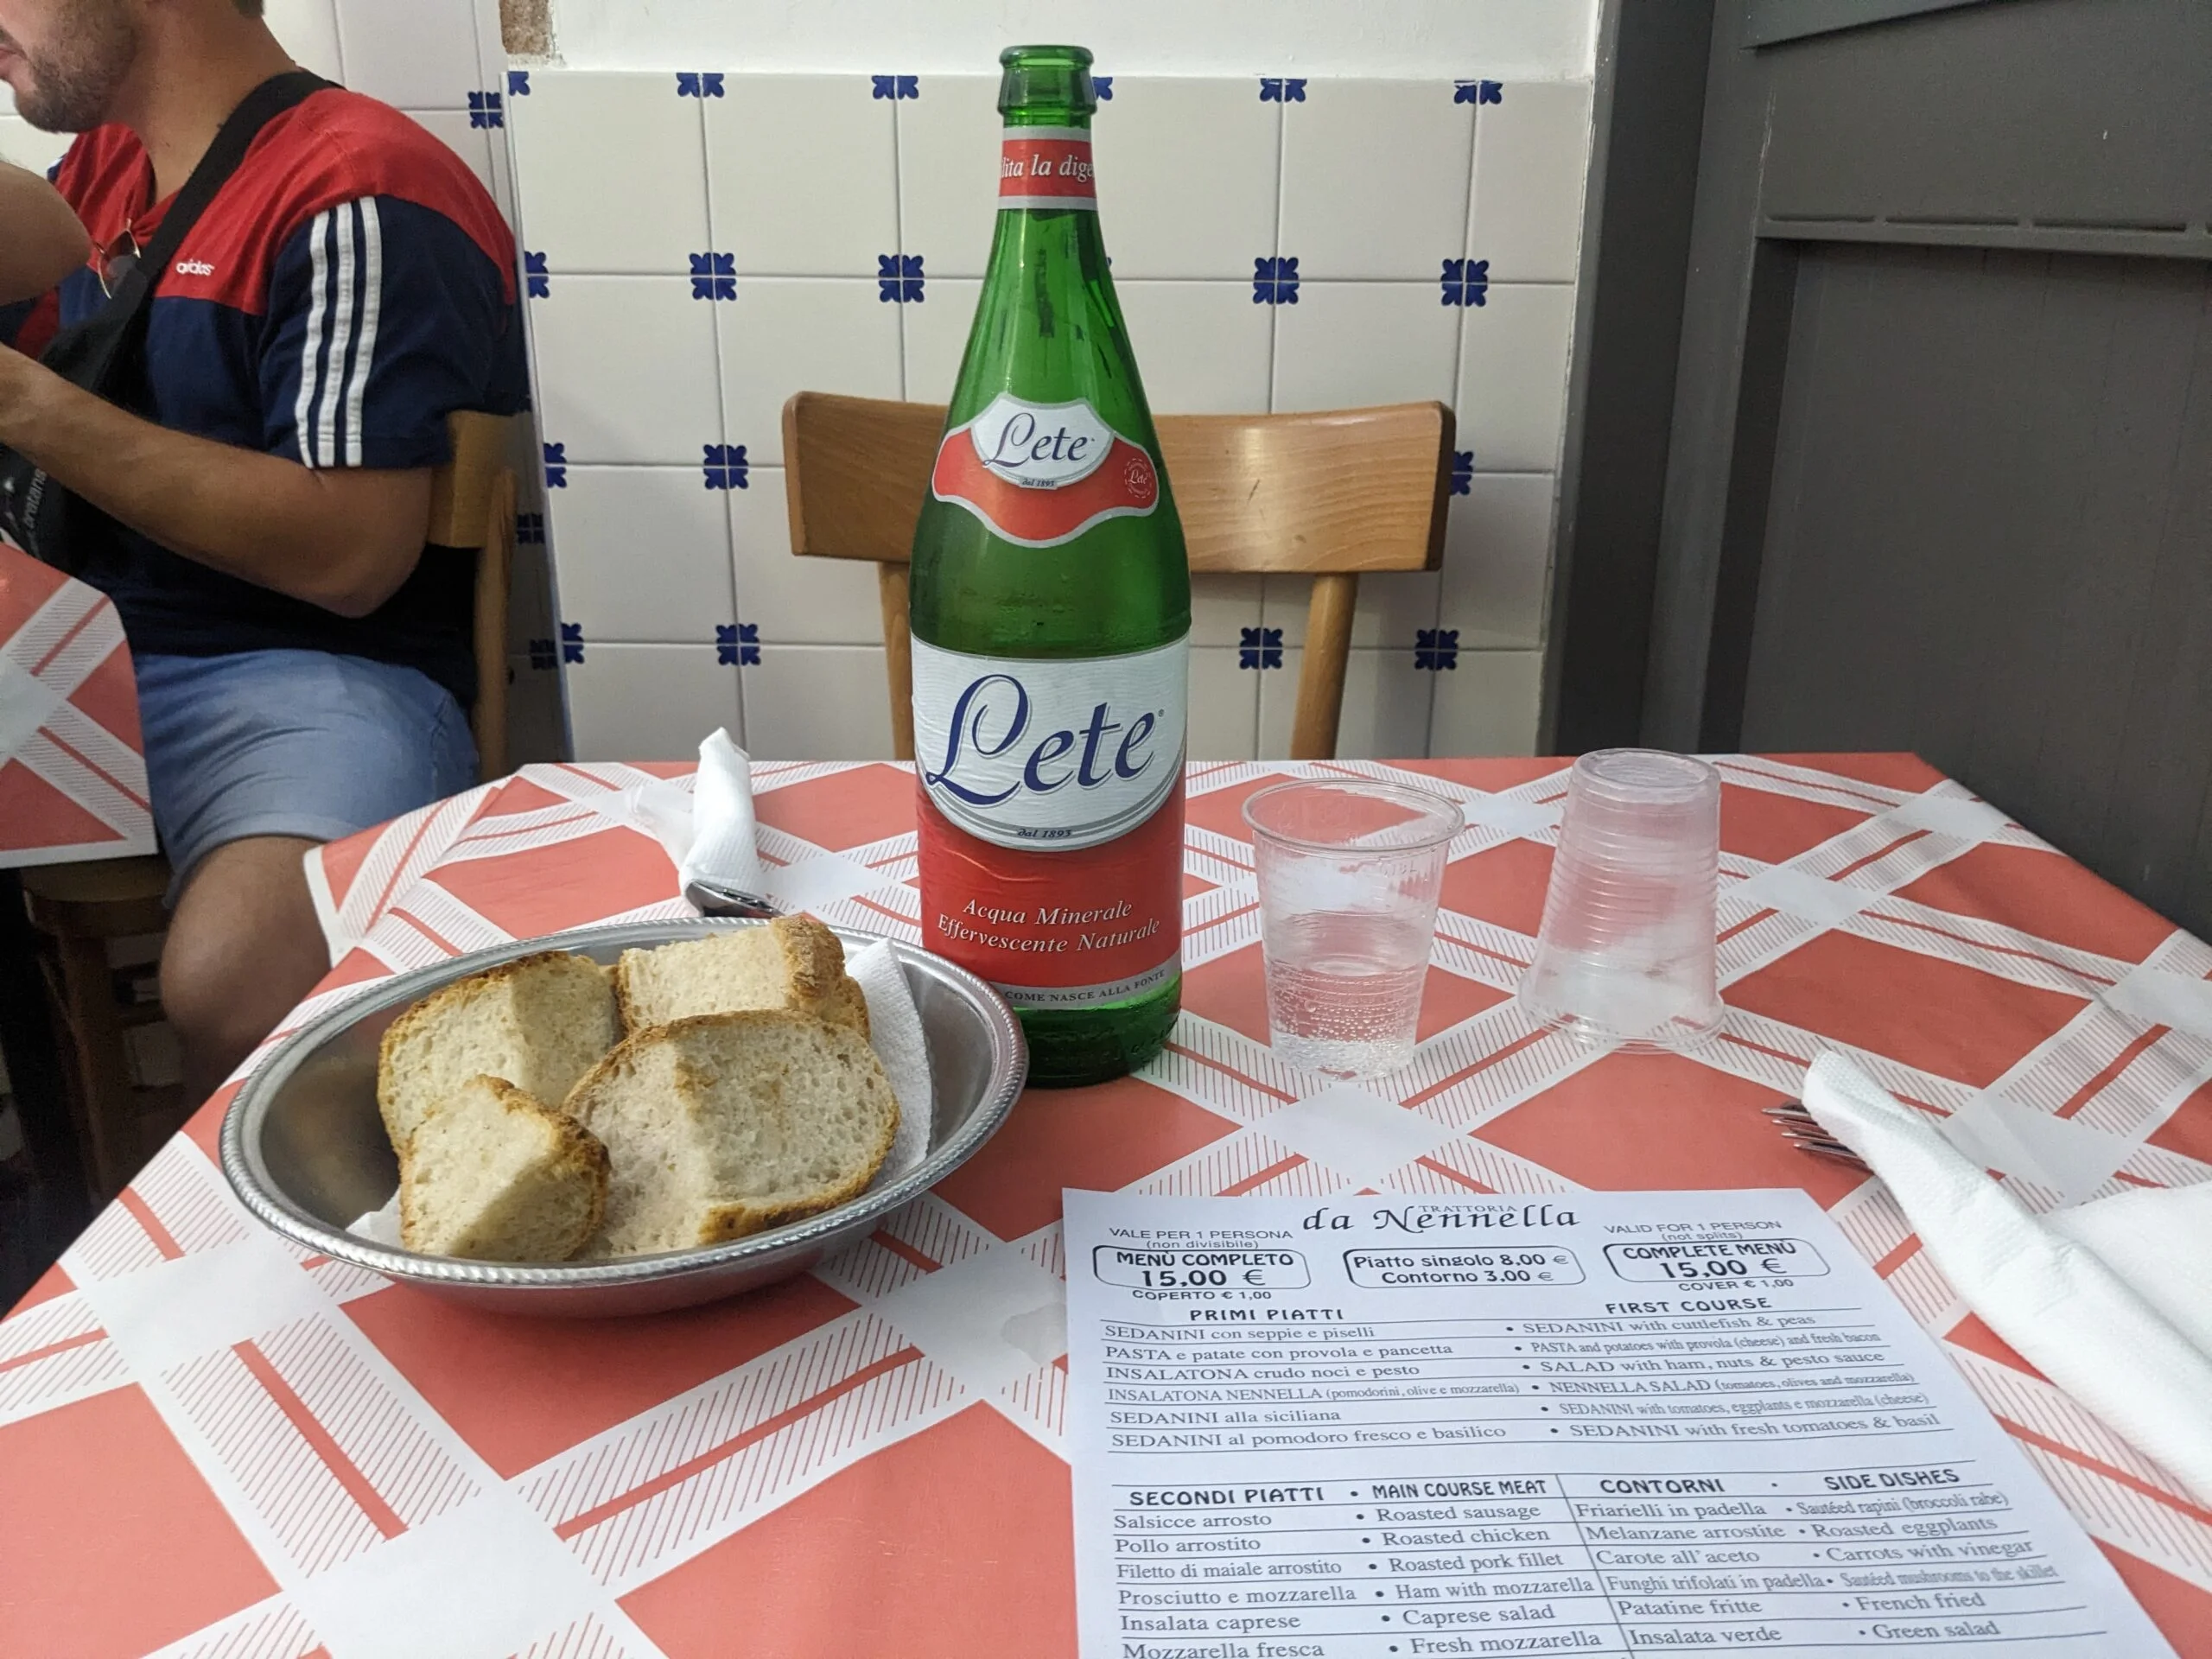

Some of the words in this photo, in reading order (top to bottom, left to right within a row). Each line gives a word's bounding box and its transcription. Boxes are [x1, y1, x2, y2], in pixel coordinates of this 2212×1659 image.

[1031, 154, 1052, 176] la
[982, 412, 1090, 467] Lete
[925, 674, 1155, 805] Lete
[1017, 828, 1039, 837] dal
[962, 899, 1027, 925] Acqua
[1033, 900, 1133, 925] Minerale
[938, 913, 1068, 952] Effervescente
[1077, 918, 1160, 951] Naturale
[1005, 991, 1045, 1001] COME
[1050, 991, 1095, 1002] NASCE
[1098, 985, 1131, 998] ALLA
[1134, 969, 1165, 989] FONTE
[1302, 1206, 1355, 1230] da
[1372, 1204, 1581, 1234] Nennella
[1603, 1224, 1653, 1234] VALID
[1656, 1223, 1694, 1233] FOR
[1696, 1223, 1706, 1231] 1
[1709, 1220, 1783, 1230] PERSON
[1109, 1227, 1152, 1239] VALE
[1155, 1230, 1191, 1240] PER
[1196, 1230, 1203, 1239] 1
[1209, 1230, 1294, 1239] PERSONA
[1661, 1233, 1693, 1242] (not
[1146, 1240, 1180, 1249] (non
[1185, 1239, 1259, 1249] divisibile)
[1622, 1243, 1735, 1260] COMPLETE
[1181, 1253, 1294, 1267] COMPLETO
[1352, 1255, 1415, 1268] Piatto
[1420, 1254, 1495, 1268] singolo
[1552, 1255, 1569, 1265] €
[1658, 1259, 1748, 1279] 15,00
[1759, 1257, 1788, 1274] €
[1141, 1269, 1228, 1287] 15,00
[1241, 1268, 1267, 1287] €
[1381, 1271, 1479, 1285] Contorno
[1536, 1271, 1554, 1281] €
[1677, 1281, 1740, 1292] COVER
[1742, 1280, 1757, 1288] €
[1759, 1278, 1795, 1289] 1,00
[1131, 1289, 1216, 1301] COPERTO
[1220, 1291, 1234, 1300] €
[1238, 1291, 1272, 1301] 1,00
[1189, 1308, 1256, 1322] PRIMI
[1266, 1308, 1344, 1321] PIATTI
[1605, 1301, 1670, 1315] FIRST
[1680, 1297, 1773, 1313] COURSE
[1104, 1325, 1205, 1341] SEDANINI
[1211, 1331, 1243, 1339] con
[1247, 1327, 1303, 1341] seppie
[1307, 1330, 1318, 1338] e
[1322, 1326, 1376, 1341] piselli
[1522, 1321, 1624, 1333] SEDANINI
[1628, 1320, 1669, 1332] with
[1756, 1316, 1774, 1327] &
[1776, 1316, 1816, 1328] peas
[1105, 1345, 1173, 1361] PASTA
[1175, 1352, 1187, 1361] e
[1192, 1350, 1246, 1363] patate
[1250, 1350, 1284, 1359] con
[1288, 1346, 1359, 1362] provola
[1377, 1344, 1454, 1359] pancetta
[1540, 1361, 1616, 1373] SALAD
[1619, 1359, 1663, 1371] with
[1663, 1358, 1713, 1370] ham,
[1714, 1358, 1755, 1369] nuts
[1759, 1355, 1777, 1367] &
[1780, 1354, 1830, 1369] pesto
[1833, 1353, 1885, 1363] sauce
[1106, 1366, 1250, 1381] INSALATONA
[1253, 1367, 1306, 1379] crudo
[1310, 1365, 1351, 1378] noci
[1355, 1368, 1367, 1376] e
[1370, 1365, 1421, 1379] pesto
[1109, 1411, 1219, 1425] SEDANINI
[1224, 1411, 1259, 1423] alla
[1263, 1409, 1342, 1422] siciliana
[1569, 1424, 1681, 1437] SEDANINI
[1684, 1423, 1728, 1436] with
[1731, 1422, 1780, 1435] fresh
[1782, 1420, 1869, 1433] tomatoes
[1872, 1416, 1892, 1429] &
[1891, 1413, 1942, 1427] basil
[1112, 1433, 1223, 1447] SEDANINI
[1228, 1433, 1245, 1446] al
[1250, 1431, 1349, 1448] pomodoro
[1352, 1429, 1412, 1442] fresco
[1416, 1431, 1427, 1440] e
[1431, 1426, 1507, 1440] basilico
[1599, 1478, 1726, 1494] CONTORNI
[1822, 1473, 1878, 1491] SIDE
[1878, 1468, 1961, 1488] DISHES
[1129, 1489, 1236, 1507] SECONDI
[1243, 1486, 1325, 1504] PIATTI
[1371, 1483, 1420, 1500] MAIN
[1423, 1481, 1496, 1498] COURSE
[1497, 1479, 1548, 1496] MEAT
[1375, 1505, 1459, 1522] Roasted
[1462, 1506, 1541, 1521] sausage
[1573, 1503, 1665, 1517] Friarielli
[1667, 1503, 1691, 1517] in
[1693, 1502, 1768, 1521] padella
[1113, 1515, 1197, 1529] Salsicce
[1202, 1514, 1273, 1528] arrosto
[1810, 1522, 1895, 1538] Roasted
[1901, 1517, 1999, 1537] eggplants
[1115, 1538, 1170, 1554] Pollo
[1175, 1536, 1262, 1553] arrostito
[1380, 1529, 1466, 1547] Roasted
[1470, 1527, 1551, 1543] chicken
[1825, 1547, 1904, 1562] Carrots
[1906, 1543, 1955, 1558] with
[1957, 1541, 2033, 1558] vinegar
[1116, 1563, 1176, 1579] Filetto
[1179, 1563, 1198, 1579] di
[1202, 1561, 1263, 1578] maiale
[1267, 1559, 1342, 1576] arrostito
[1387, 1554, 1466, 1573] Roasted
[1469, 1553, 1516, 1573] pork
[1516, 1552, 1565, 1567] fillet
[1118, 1589, 1222, 1605] Prosciutto
[1227, 1592, 1240, 1604] e
[1245, 1586, 1357, 1604] mozzarella
[1394, 1584, 1442, 1599] Ham
[1445, 1581, 1488, 1598] with
[1491, 1576, 1596, 1596] mozzarella
[1119, 1615, 1210, 1631] Insalata
[1216, 1617, 1301, 1635] caprese
[1402, 1609, 1492, 1629] Caprese
[1497, 1603, 1557, 1622] salad
[1627, 1628, 1718, 1645] Insalata
[1719, 1625, 1783, 1643] verde
[1872, 1624, 1942, 1639] Green
[1943, 1620, 2002, 1637] salad
[1121, 1643, 1251, 1659] Mozzarella
[1255, 1641, 1325, 1658] fresca
[1409, 1636, 1474, 1654] Fresh
[1478, 1630, 1604, 1652] mozzarella
